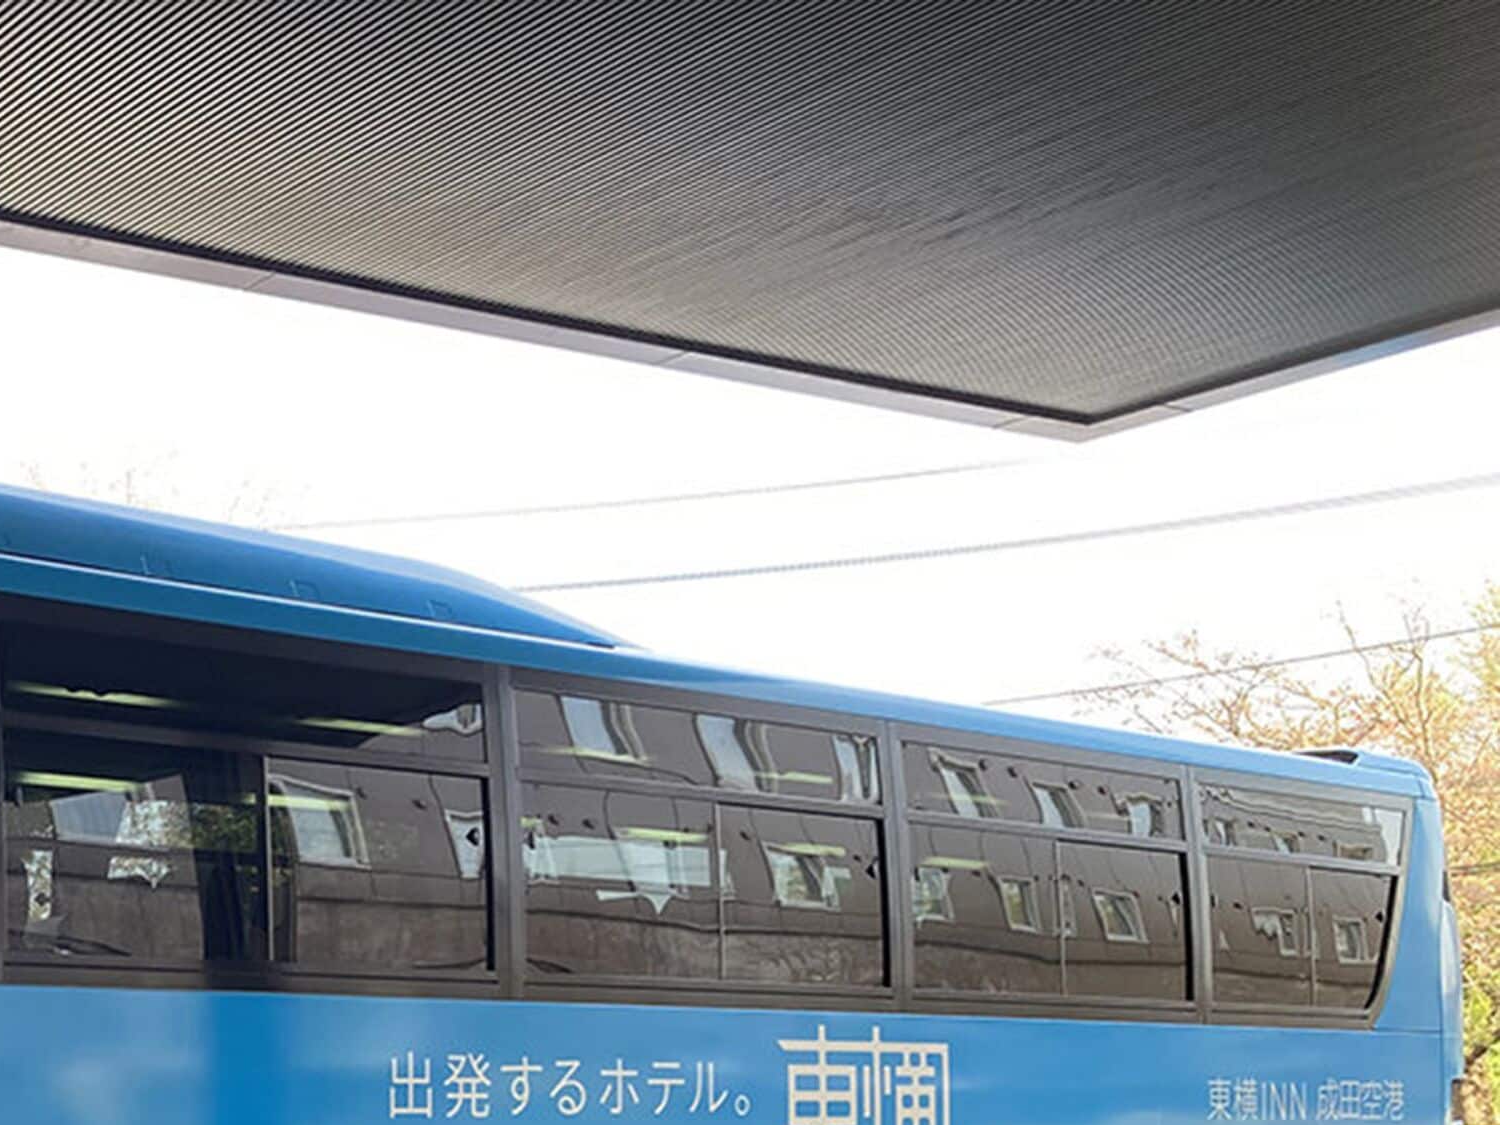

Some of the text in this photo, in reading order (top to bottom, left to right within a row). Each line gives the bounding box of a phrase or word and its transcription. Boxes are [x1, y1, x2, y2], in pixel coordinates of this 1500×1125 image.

[388, 1050, 750, 1118] 出発するホテル。
[1207, 1077, 1405, 1120] 東横INN 成田空港
